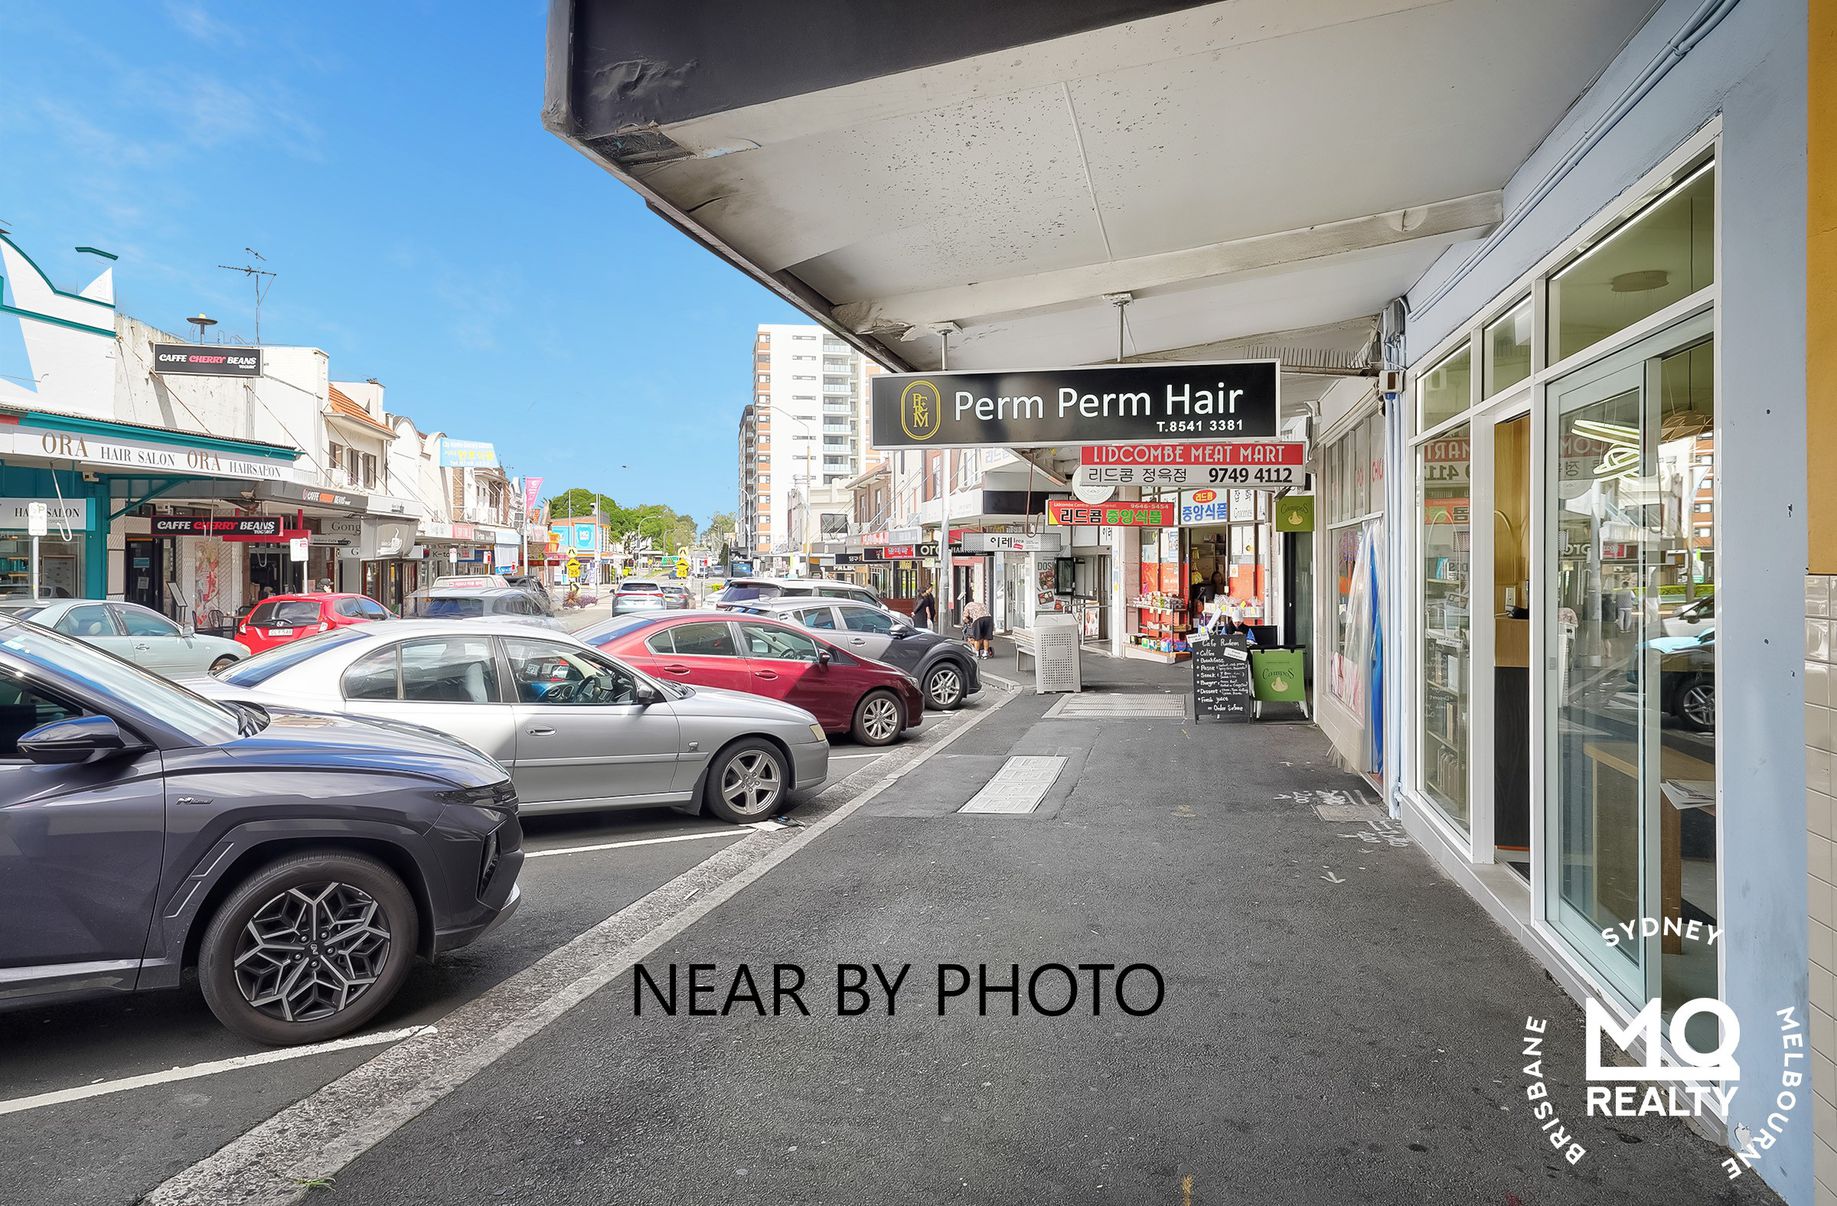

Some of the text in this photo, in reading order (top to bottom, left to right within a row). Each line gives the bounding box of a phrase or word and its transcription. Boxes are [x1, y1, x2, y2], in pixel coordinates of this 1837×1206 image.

[159, 353, 257, 365] CAFFE CHERRY BEANS
[955, 381, 1243, 421] Perm Perm Hair
[1156, 419, 1243, 432] T.8541 3381
[42, 431, 89, 458] ORA
[101, 446, 131, 462] HAIR
[138, 451, 175, 467] SALON
[187, 448, 221, 472] ORA
[1094, 445, 1285, 463] LIDCOMBE MEAT MART
[1089, 467, 1292, 483] 리드콤 정육점 9749 4112
[1061, 508, 1163, 524] 리드콤 중앙식품
[1182, 502, 1227, 523] 중앙식품
[157, 520, 275, 530] CAFFE CHERRY BEANS
[990, 536, 1013, 548] 이레
